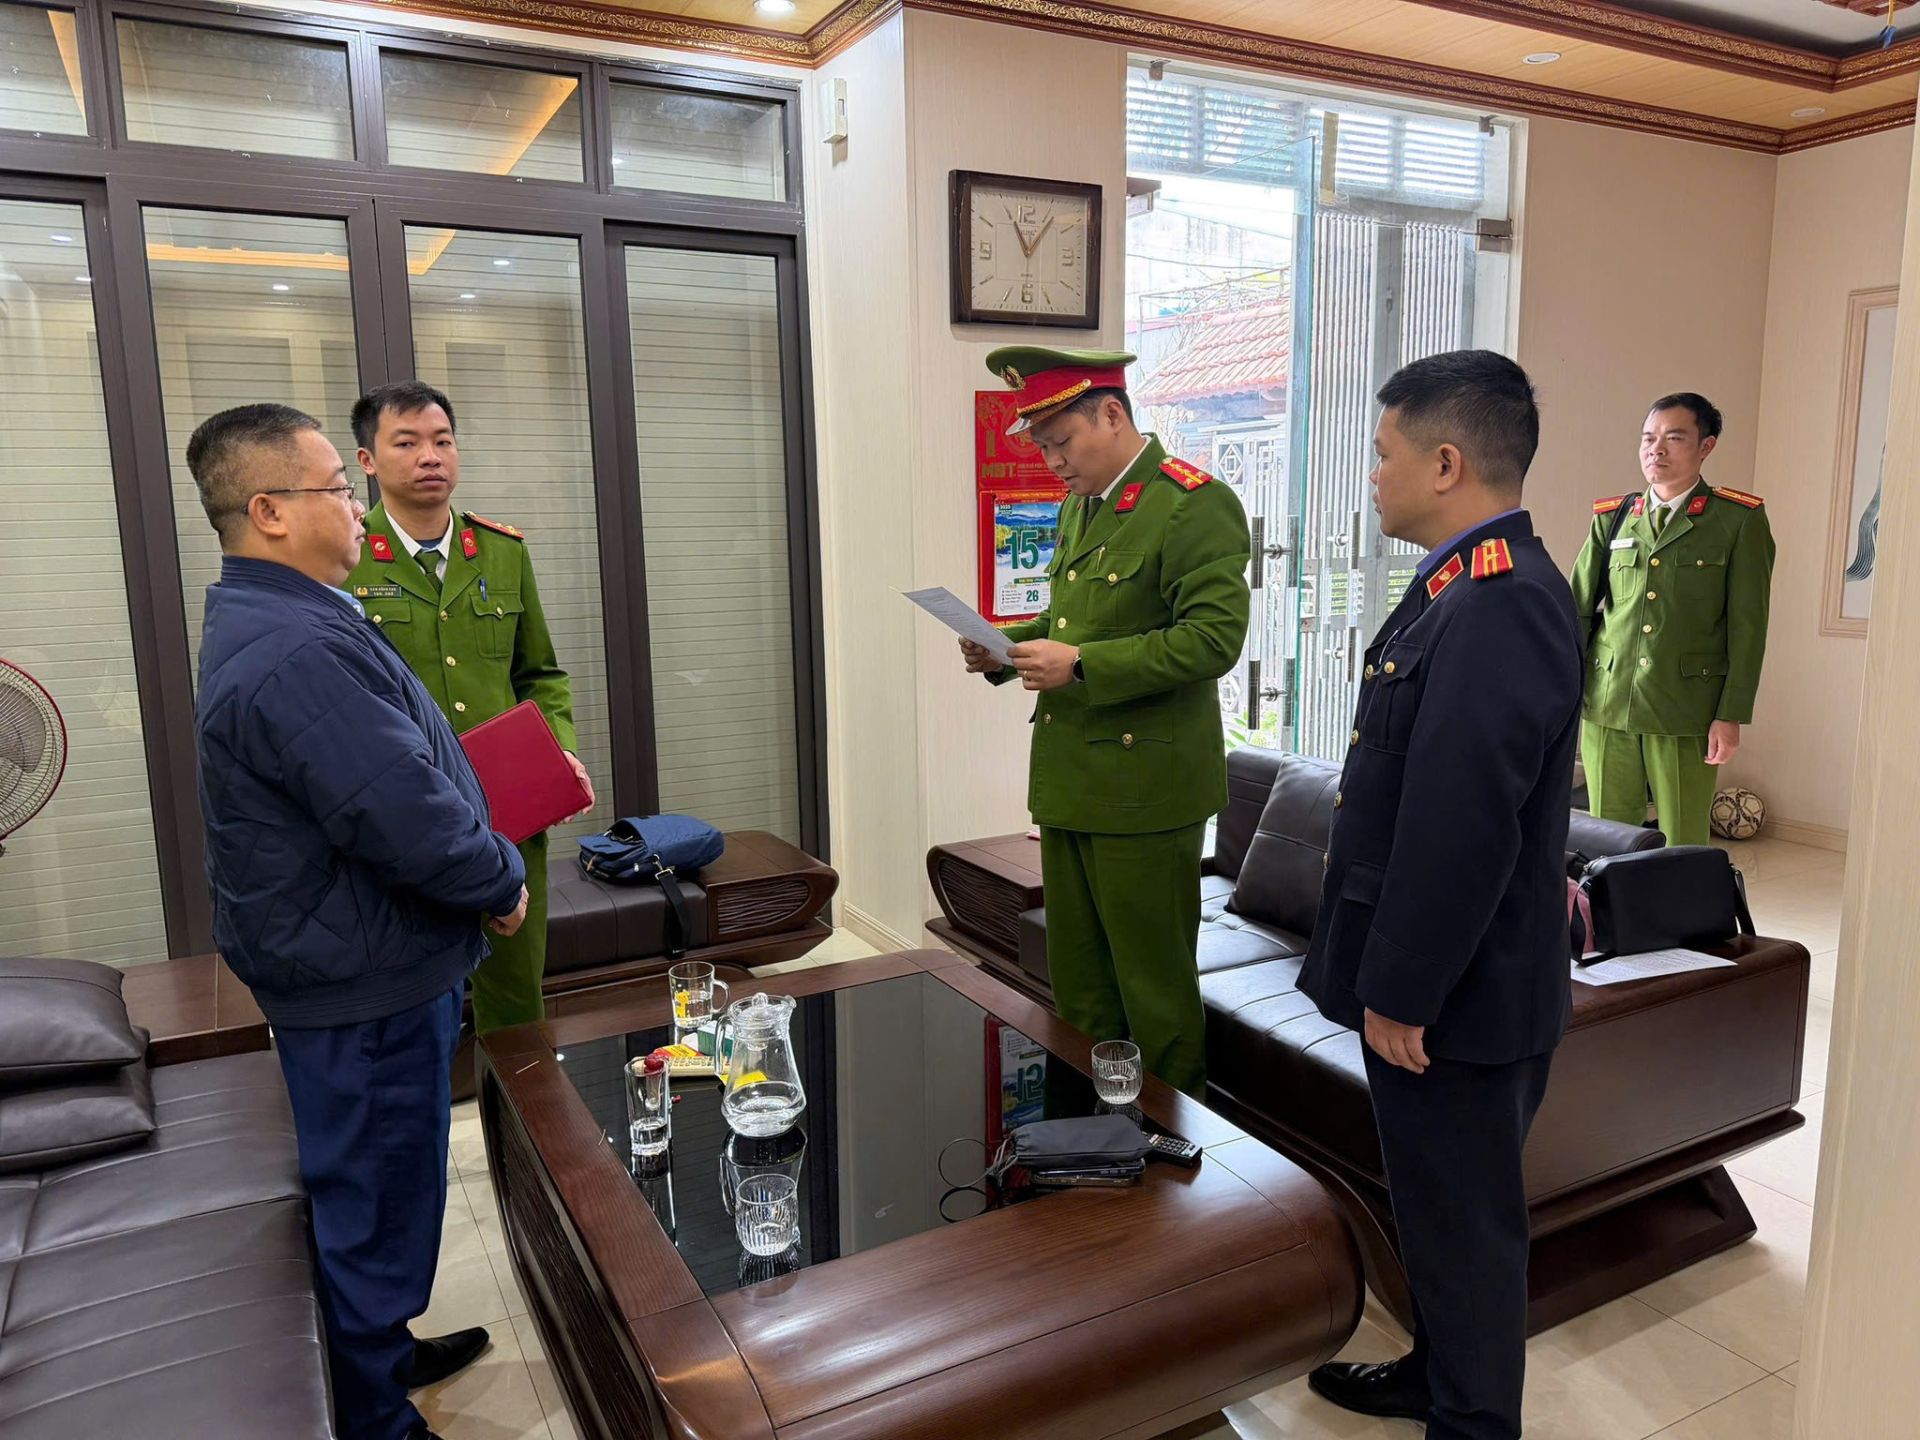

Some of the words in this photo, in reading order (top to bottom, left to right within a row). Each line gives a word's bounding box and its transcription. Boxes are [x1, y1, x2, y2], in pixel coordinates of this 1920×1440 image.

[1018, 204, 1036, 223] 12
[979, 241, 992, 260] 9
[1062, 248, 1074, 266] 3
[1021, 283, 1034, 303] 6
[1004, 530, 1039, 570] 15
[1026, 590, 1039, 602] 26
